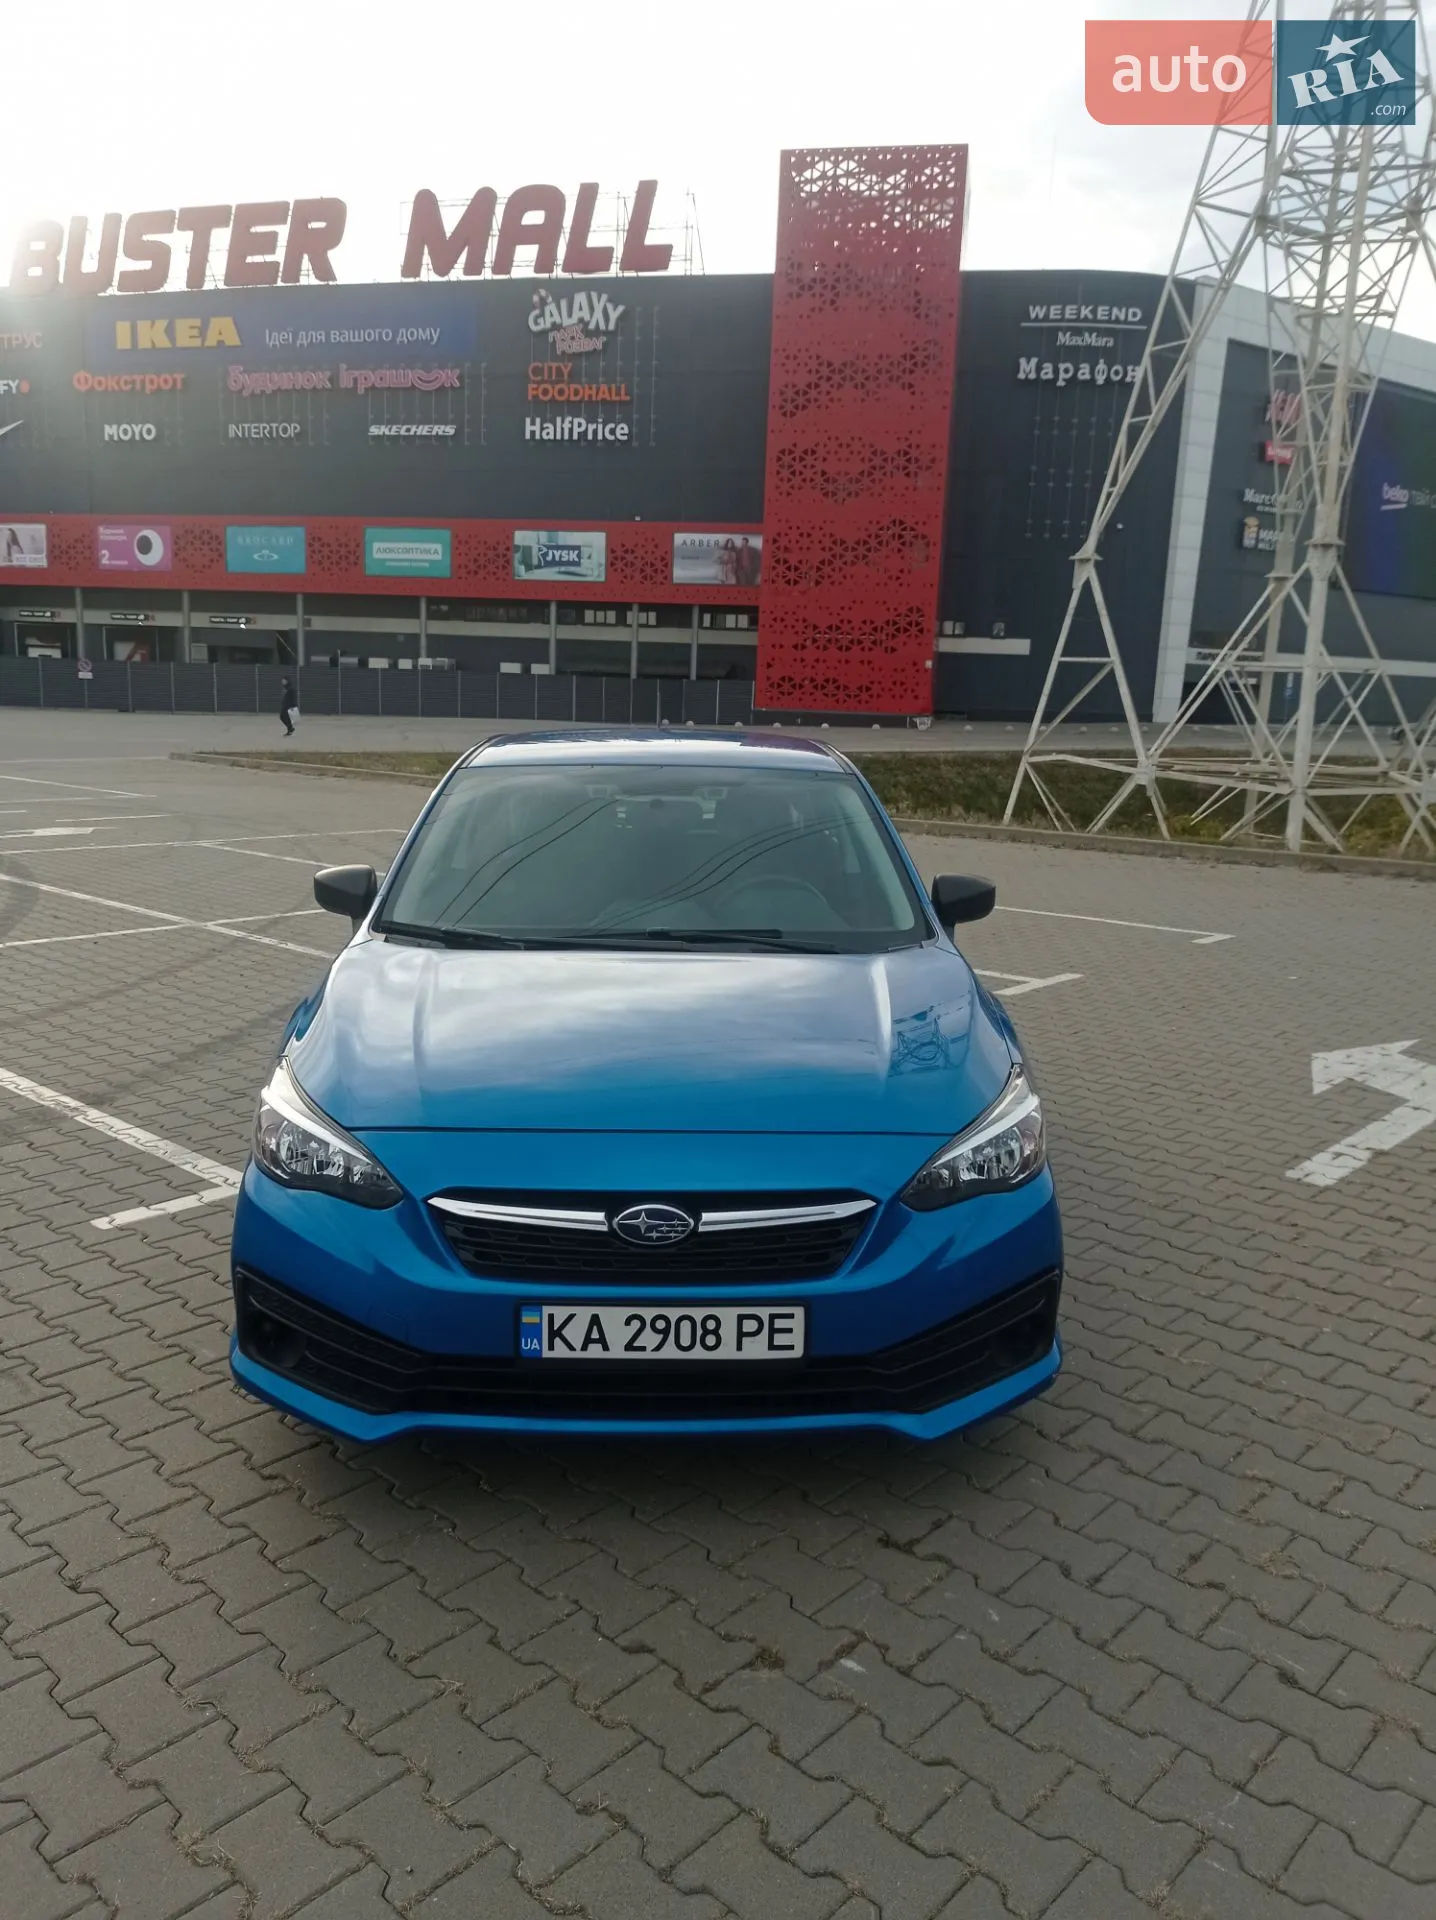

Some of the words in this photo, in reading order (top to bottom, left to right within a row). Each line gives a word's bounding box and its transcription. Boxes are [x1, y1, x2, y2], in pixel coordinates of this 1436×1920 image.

[9, 197, 347, 294] BUSTER
[401, 179, 673, 278] MALL
[527, 290, 626, 332] GALAXY
[1029, 304, 1142, 322] WEEKEND
[115, 316, 242, 350] IKEA
[265, 328, 293, 348] Ідеї
[297, 329, 326, 347] для
[330, 328, 392, 343] вашого
[396, 327, 440, 344] дому
[1056, 331, 1114, 348] MaxMara
[528, 362, 572, 380] CITY
[1017, 357, 1141, 386] Марафон
[72, 370, 185, 393] Фокстрот
[527, 384, 630, 401] FOODHALL
[104, 423, 156, 441] MOYO
[228, 423, 300, 438] INTERTOP
[368, 424, 456, 436] SKECHERS
[525, 417, 629, 441] HalfPrice
[681, 538, 720, 549] ARBER
[101, 550, 109, 565] 2
[546, 549, 580, 562] JYSK
[547, 1313, 610, 1351] KA
[623, 1313, 722, 1352] 2908
[736, 1312, 795, 1351] PE
[521, 1338, 540, 1350] UA
